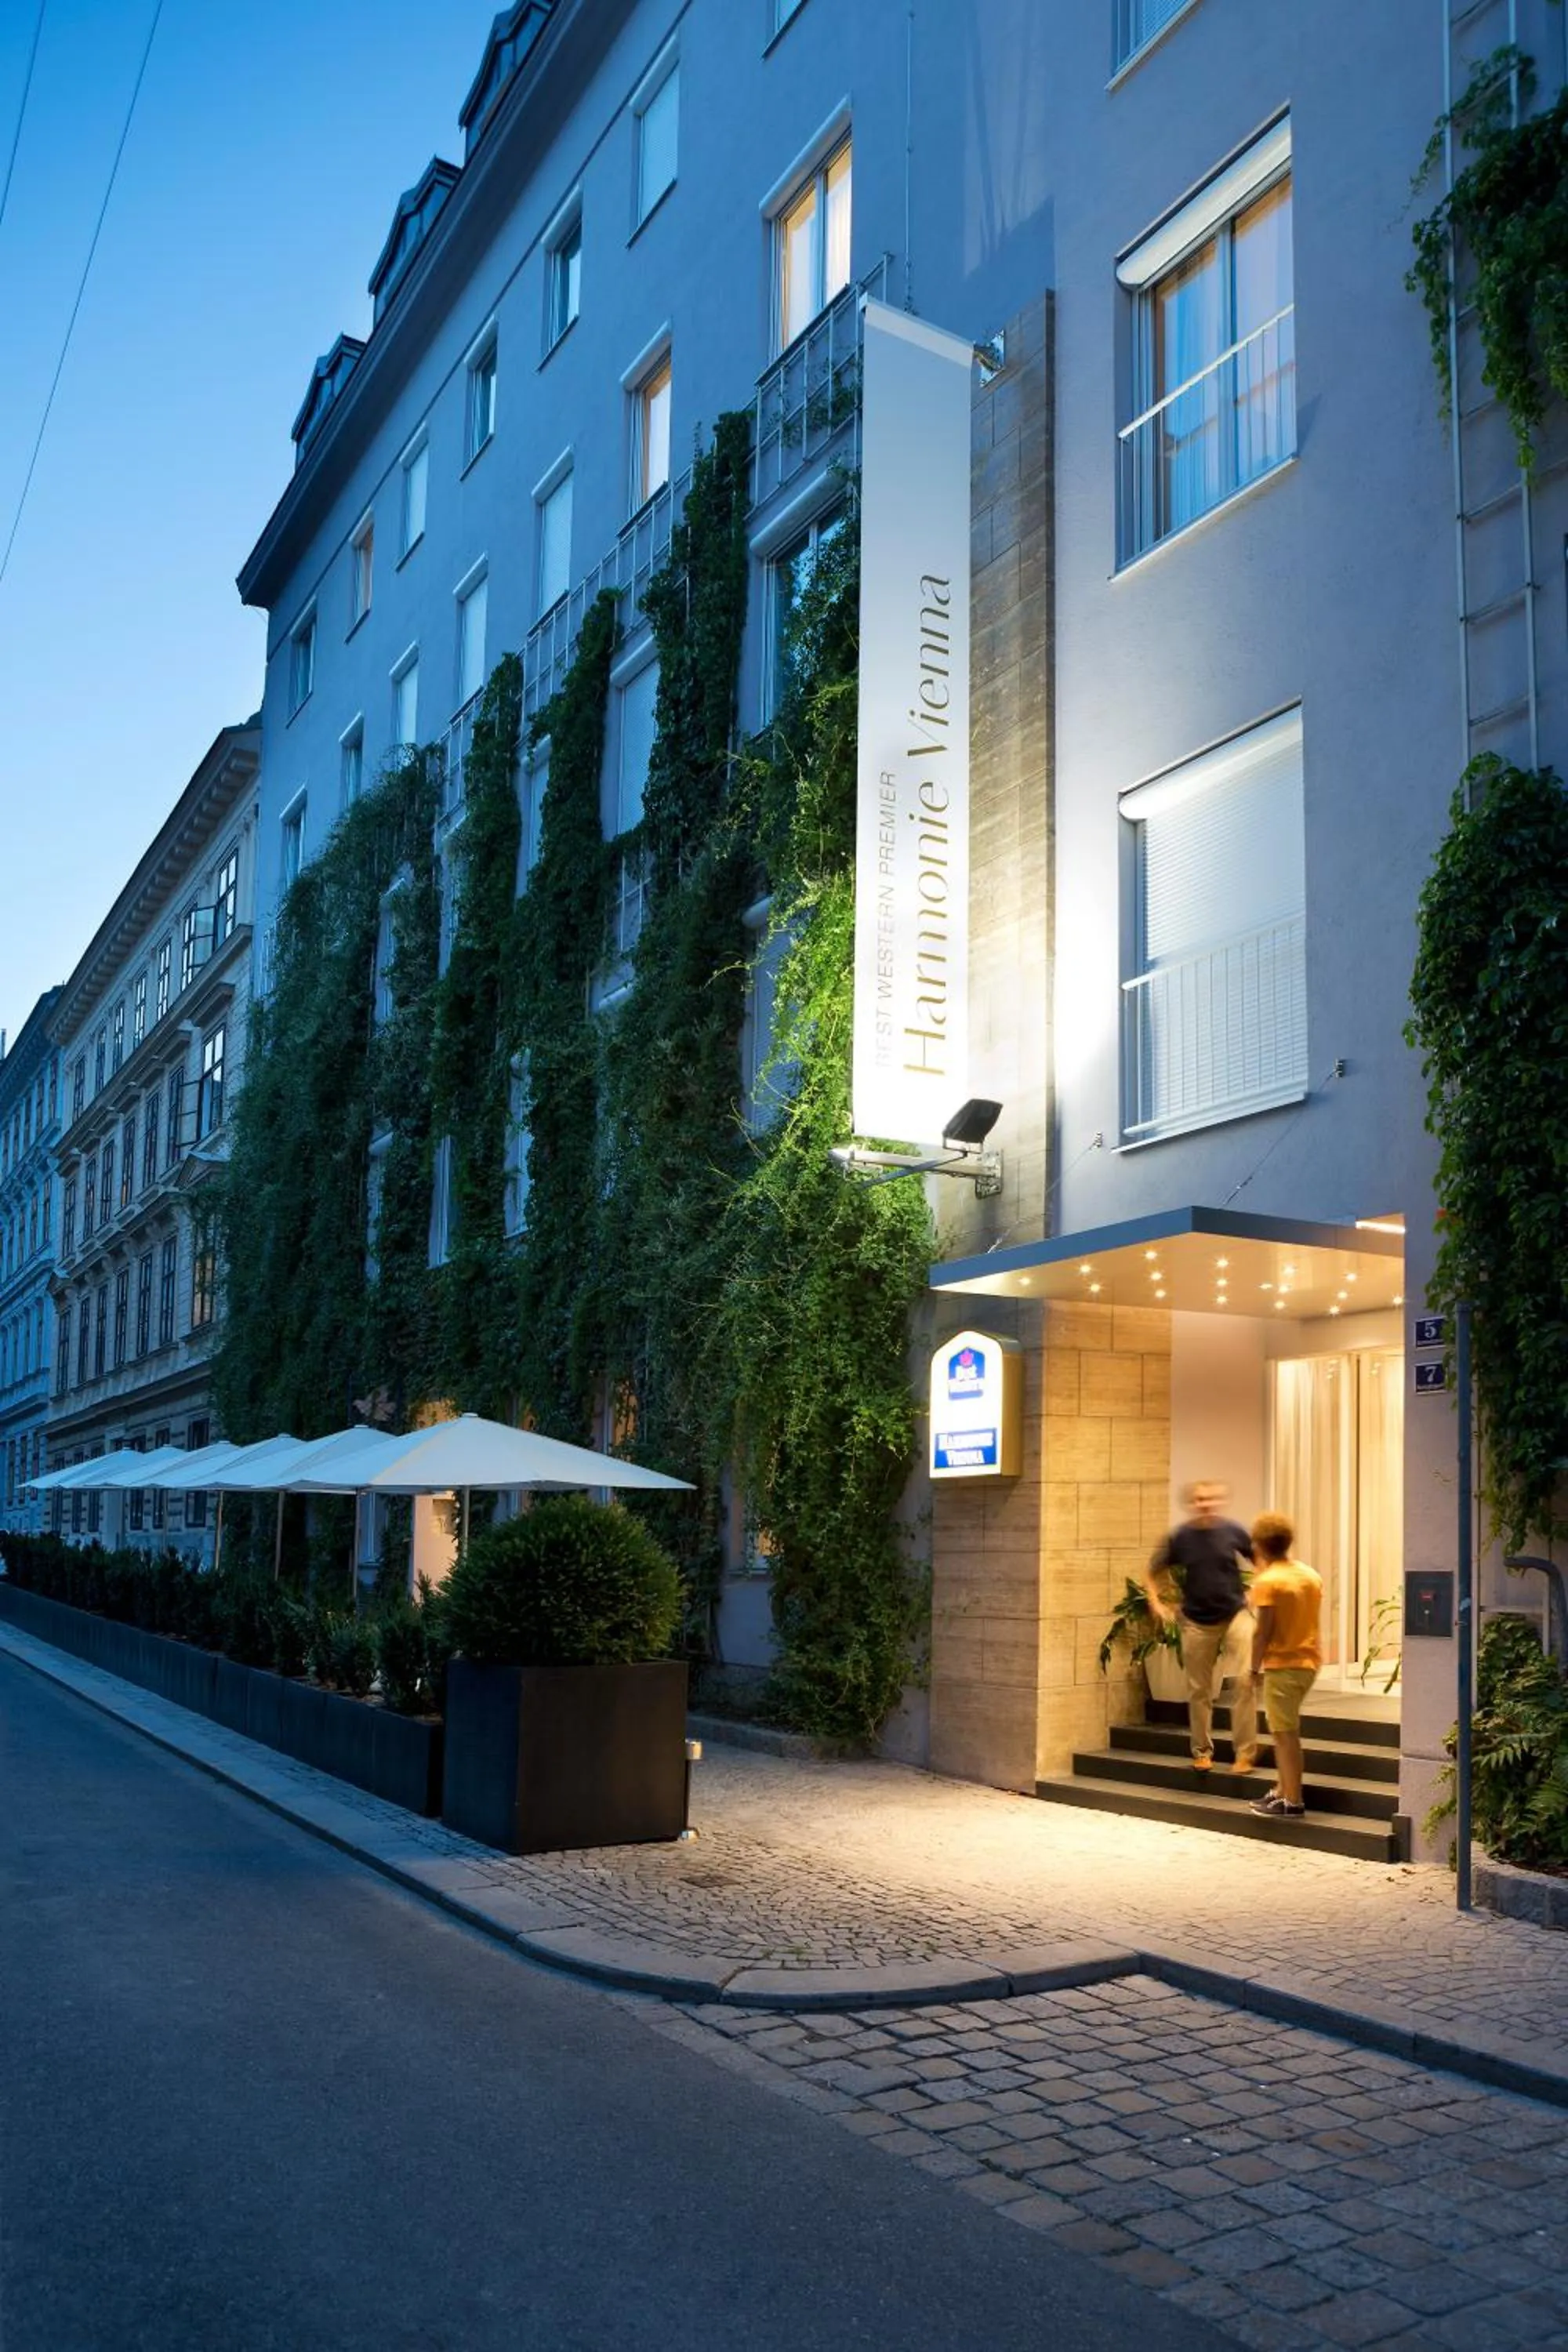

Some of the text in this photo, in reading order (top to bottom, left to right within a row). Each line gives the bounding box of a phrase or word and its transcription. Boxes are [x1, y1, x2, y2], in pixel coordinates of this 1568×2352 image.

[879, 771, 895, 876] PREMIER
[903, 575, 950, 1076] Harmonie Vienna
[878, 885, 895, 999] WESTERN
[1425, 1321, 1436, 1338] 5
[1425, 1366, 1436, 1383] 7
